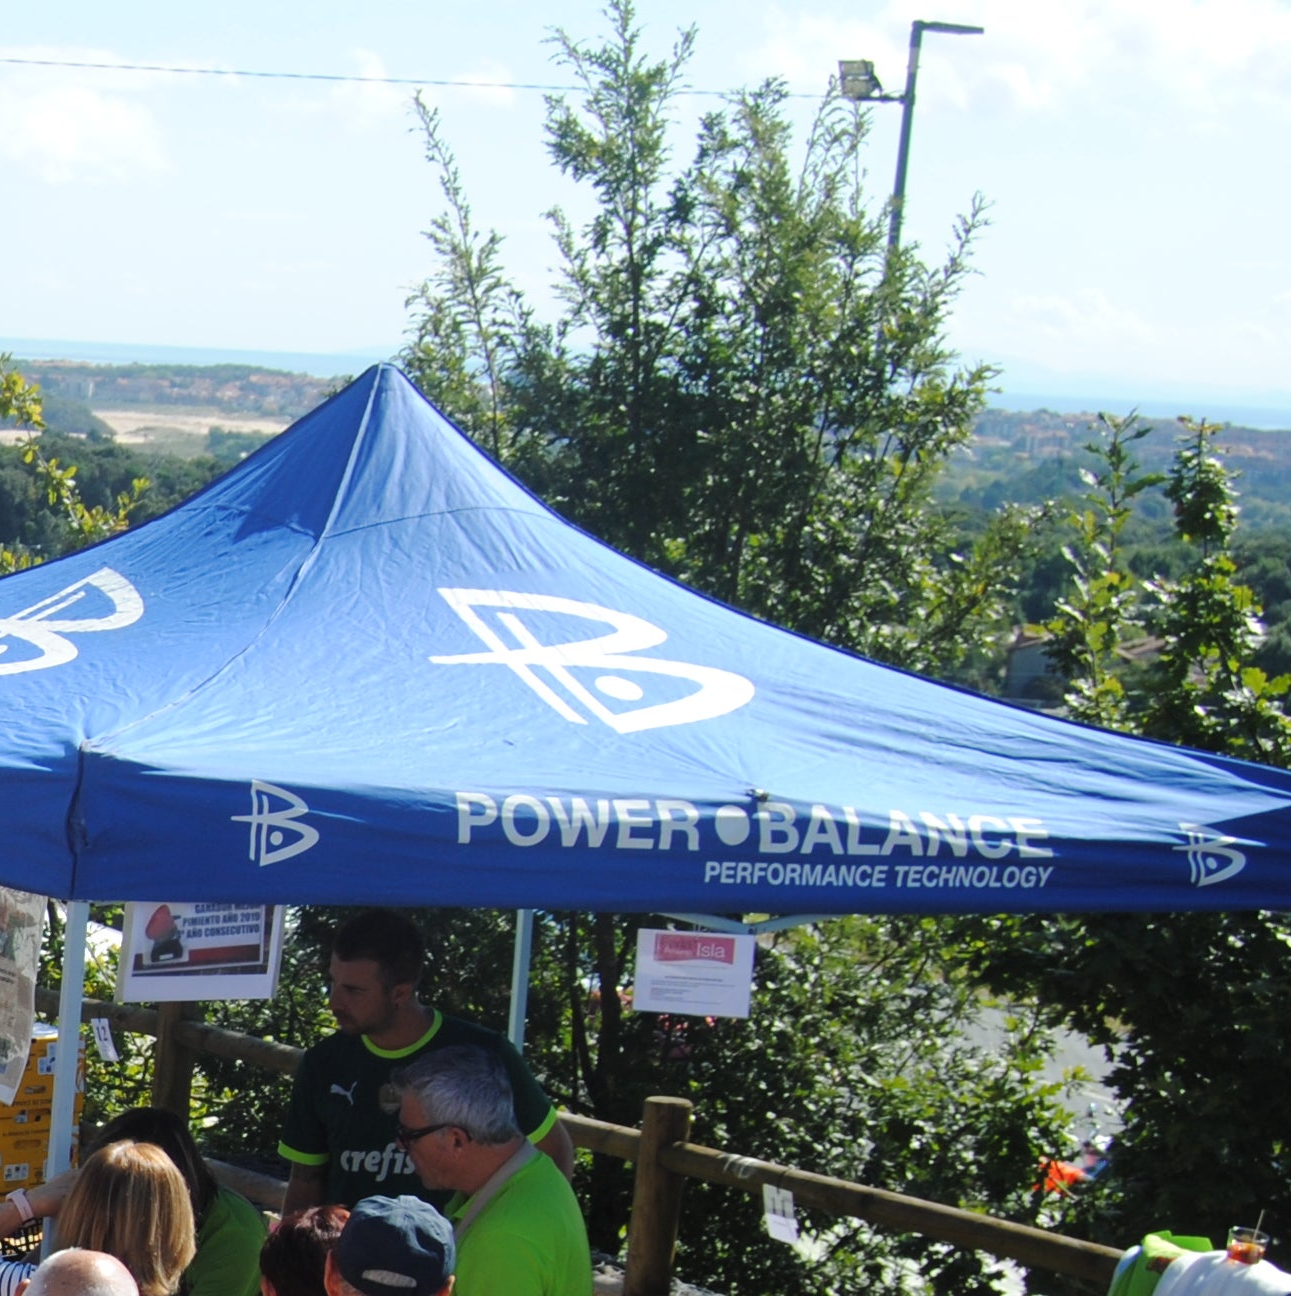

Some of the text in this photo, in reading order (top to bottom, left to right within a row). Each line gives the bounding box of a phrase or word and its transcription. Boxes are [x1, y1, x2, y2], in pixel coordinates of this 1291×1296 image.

[455, 791, 1054, 859] POWER BALANCE
[704, 861, 1054, 888] PERFORMANCE TECHNOLOGY
[696, 941, 726, 959] Isla
